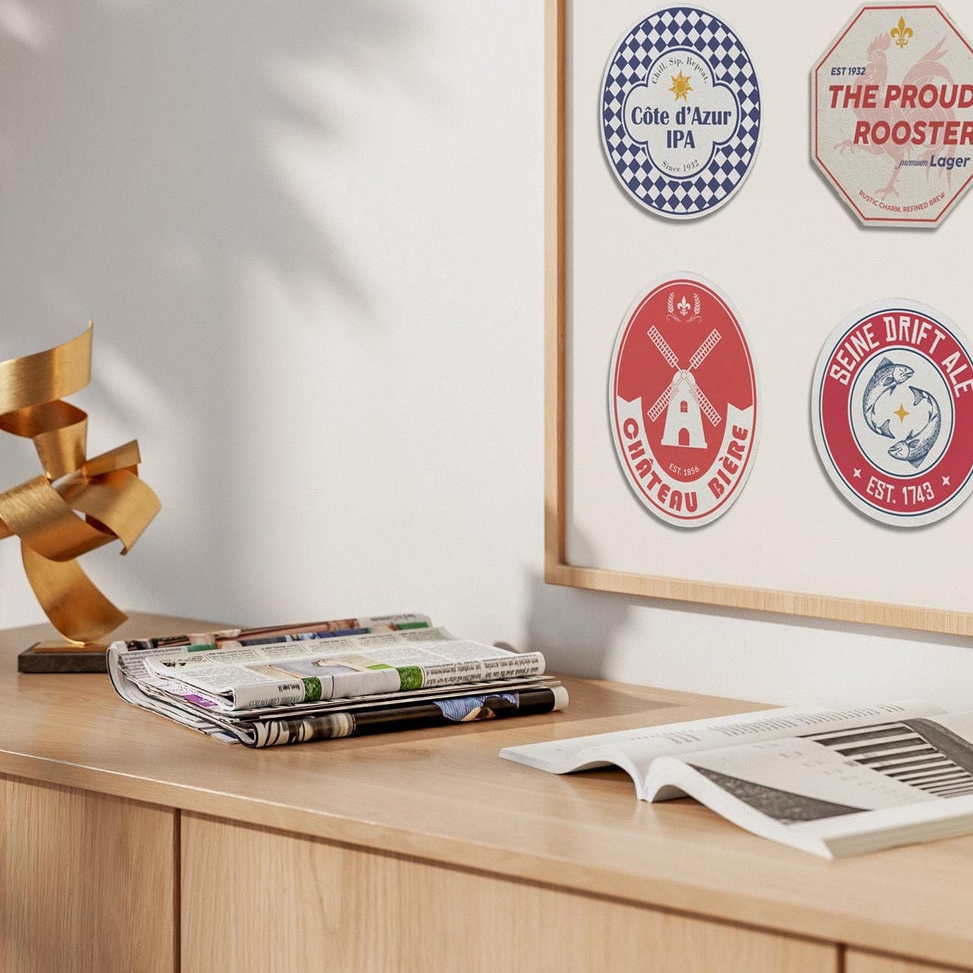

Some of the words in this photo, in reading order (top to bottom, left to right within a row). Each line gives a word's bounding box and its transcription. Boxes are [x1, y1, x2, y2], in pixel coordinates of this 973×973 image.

[831, 67, 847, 76] EST
[848, 67, 866, 76] 1932
[829, 85, 879, 108] THE
[631, 106, 669, 125] Côte
[676, 106, 731, 125] d'Azur
[666, 130, 695, 148] IPA
[662, 160, 680, 172] Since
[683, 159, 699, 172] 1932
[930, 155, 970, 170] Lager
[859, 190, 878, 206] RUSTIC
[903, 202, 928, 212] REFINED
[928, 192, 945, 206] BREW
[830, 323, 880, 385] SEINE
[883, 316, 946, 354] DRIFT
[623, 417, 698, 513] CHÂTEAU
[707, 425, 748, 499] BIÈRE
[669, 463, 682, 475] EST.
[684, 465, 700, 476] 1856
[866, 476, 896, 504] EST.
[902, 482, 934, 505] 1743
